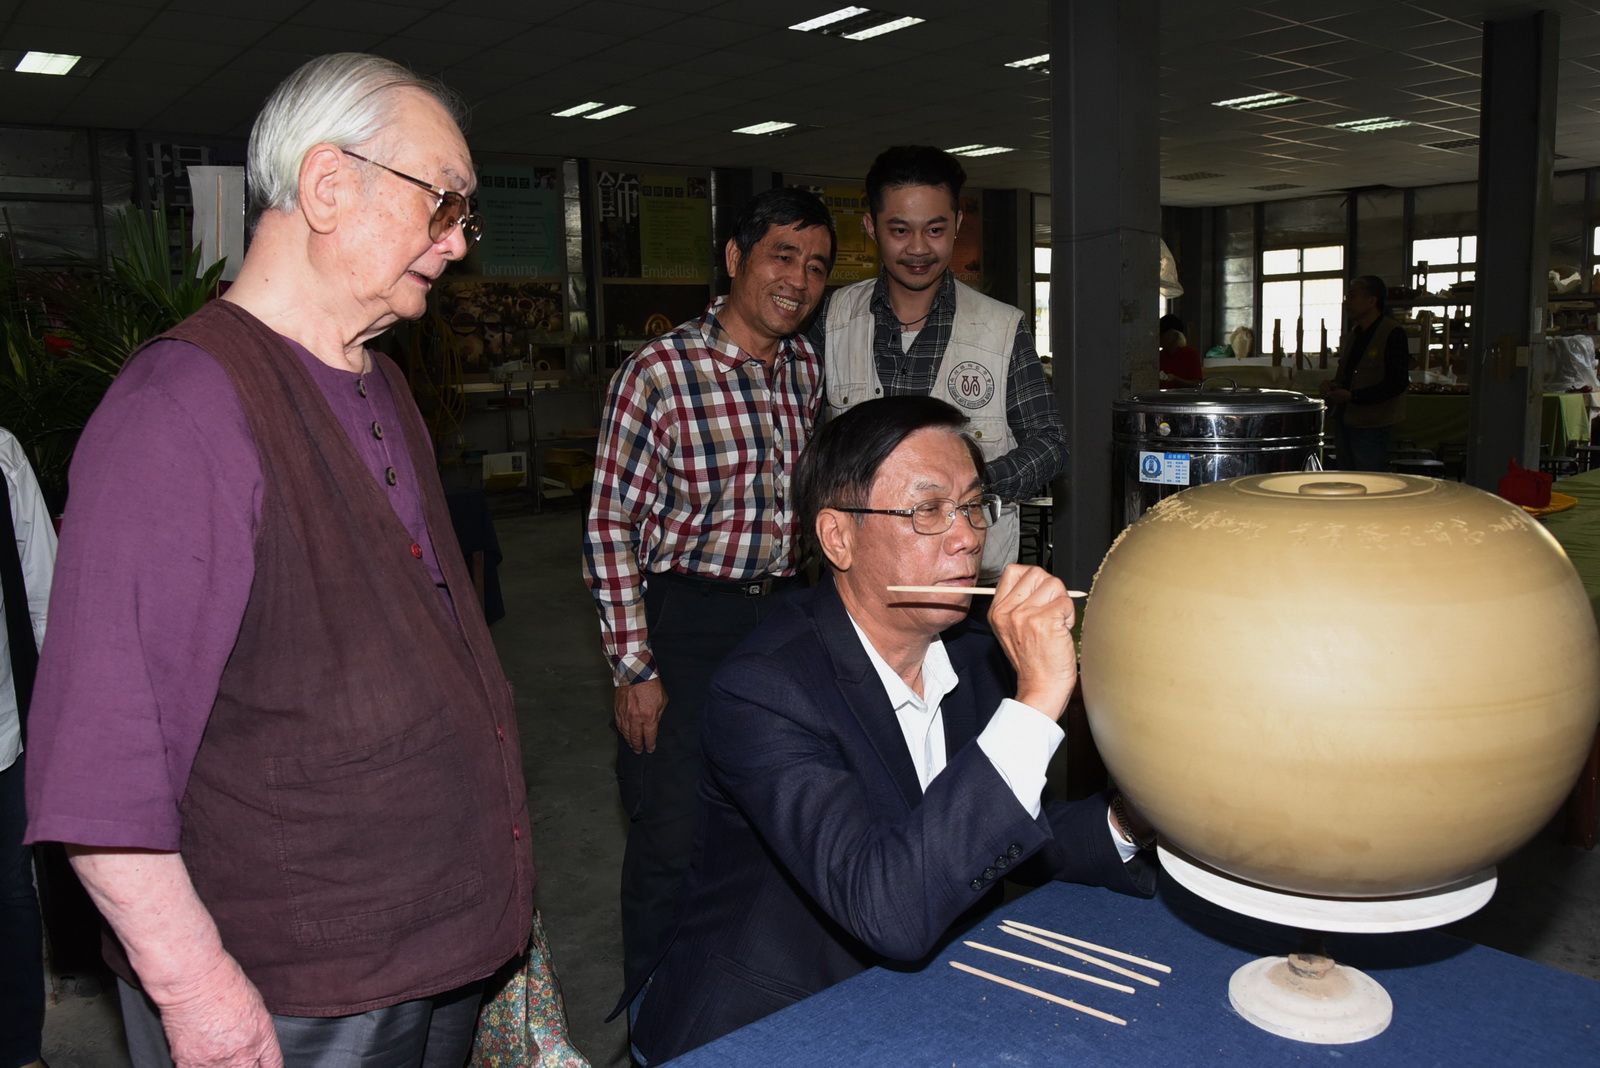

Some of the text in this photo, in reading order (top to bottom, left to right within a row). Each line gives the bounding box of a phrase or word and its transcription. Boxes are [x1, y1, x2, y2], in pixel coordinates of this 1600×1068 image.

[597, 171, 639, 224] 飾
[482, 261, 538, 279] Forming
[641, 264, 699, 279] Embellish
[829, 271, 860, 280] rocess
[954, 270, 980, 281] eramic
